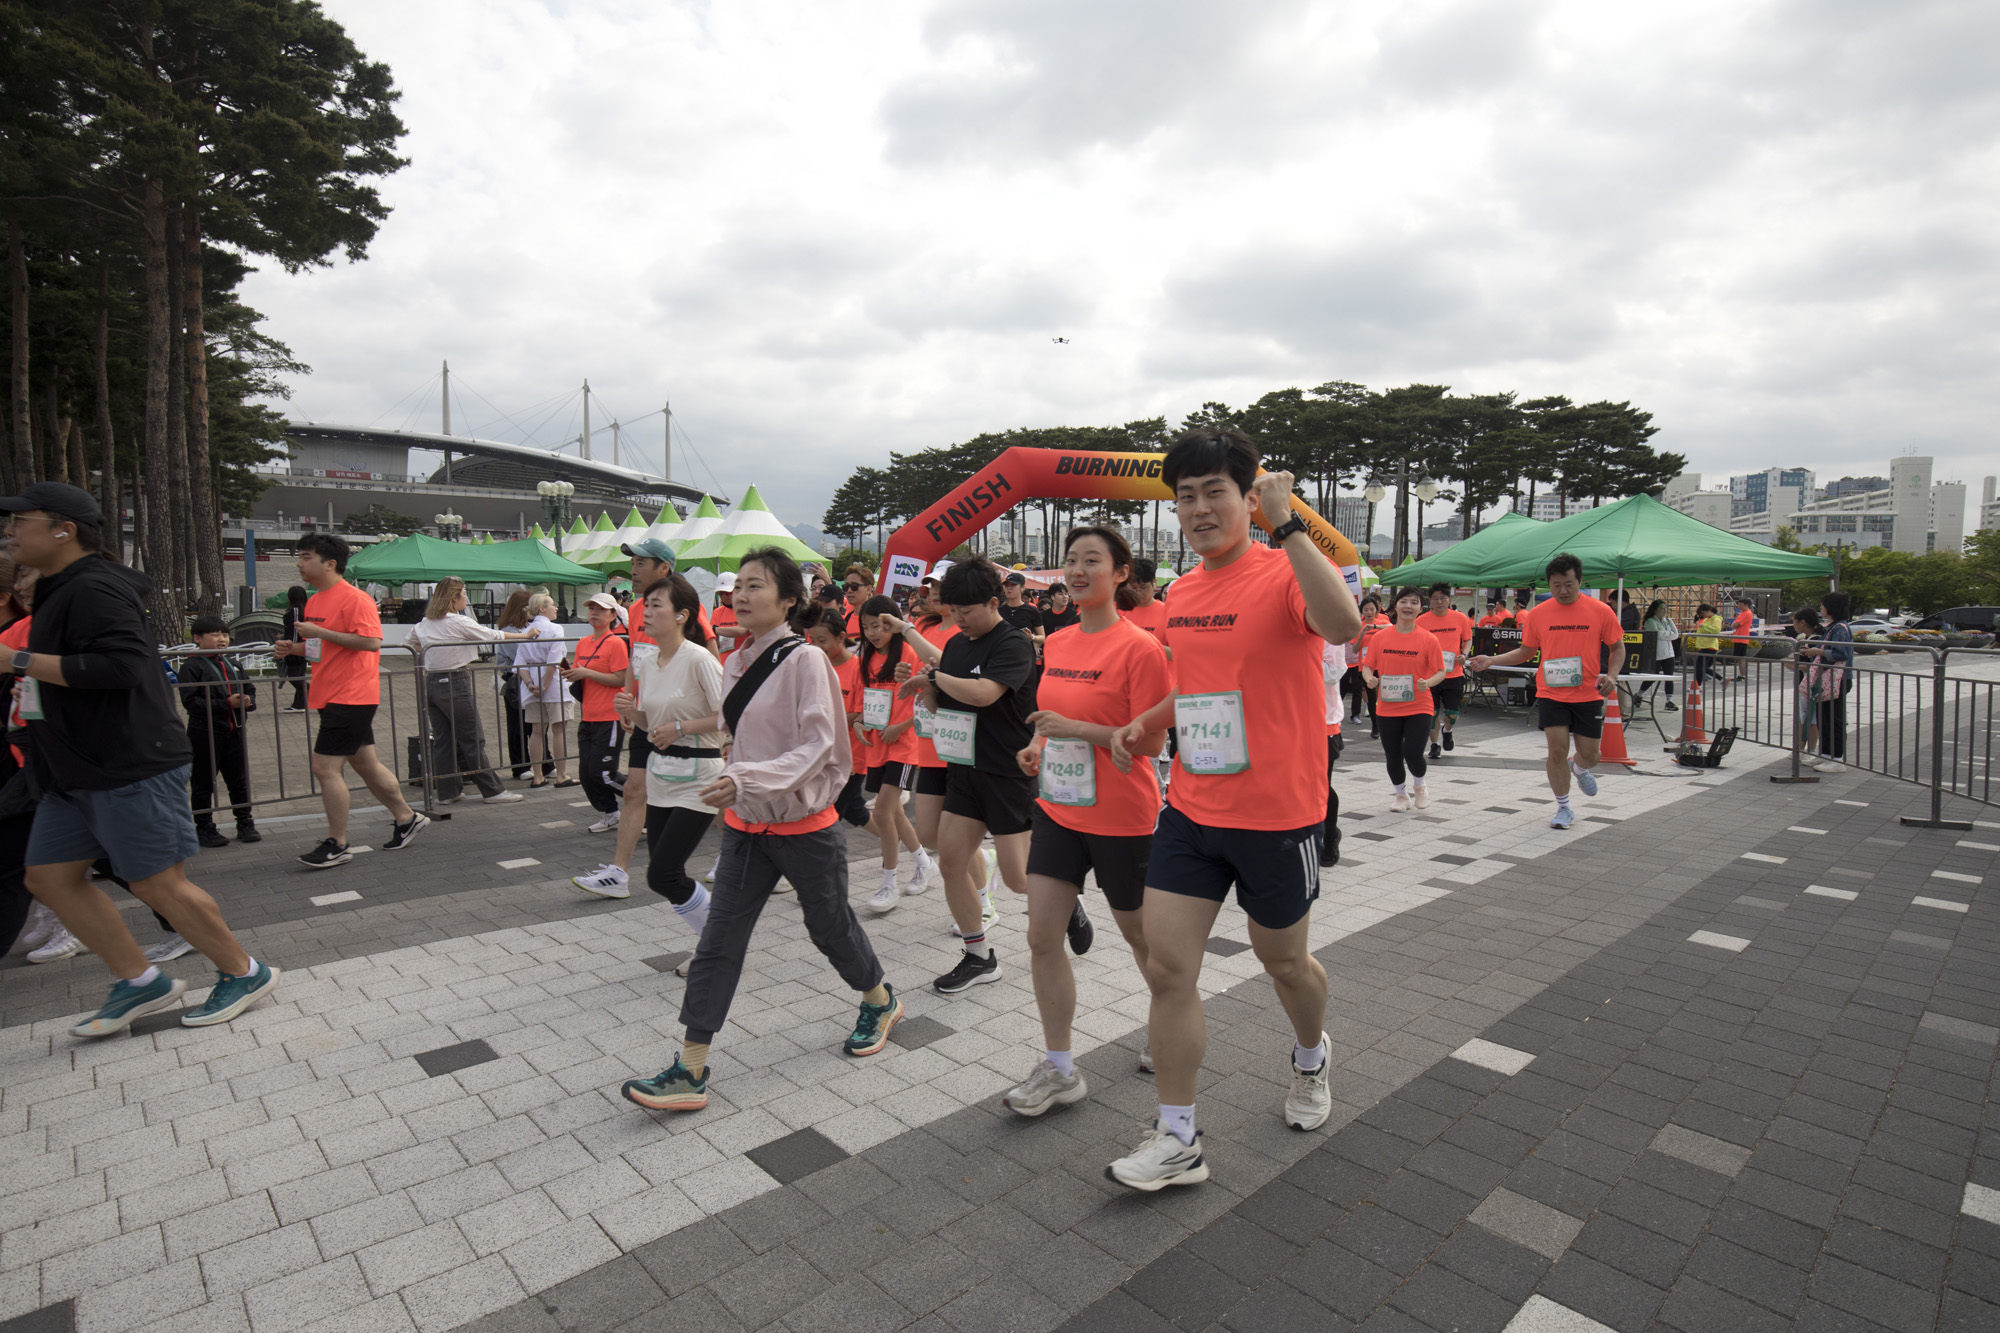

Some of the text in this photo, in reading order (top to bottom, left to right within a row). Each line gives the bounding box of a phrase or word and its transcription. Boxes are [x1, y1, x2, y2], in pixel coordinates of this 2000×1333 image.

[1055, 456, 1162, 478] BURNING
[925, 472, 1012, 543] FINISH
[1166, 613, 1238, 628] BURNING RUN
[1199, 700, 1213, 708] RUN
[939, 727, 968, 742] 8403
[1180, 721, 1232, 740] M 7141
[1194, 756, 1218, 765] C-574
